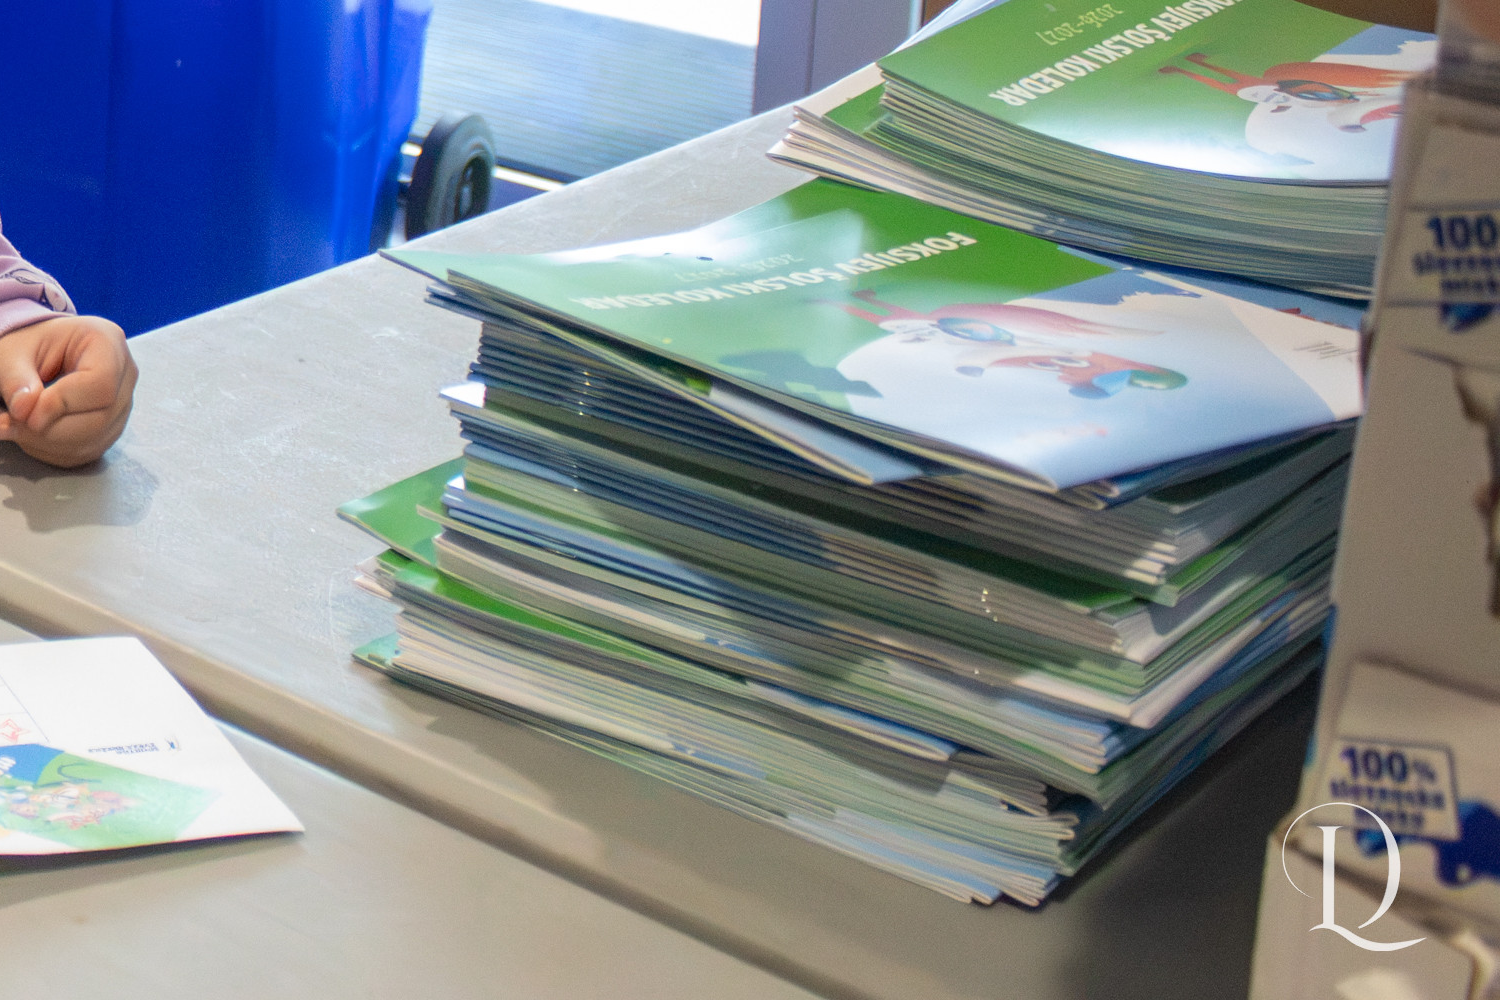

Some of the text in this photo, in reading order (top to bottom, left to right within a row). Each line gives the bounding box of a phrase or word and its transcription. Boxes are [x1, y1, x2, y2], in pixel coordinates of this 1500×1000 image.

[1082, 23, 1172, 64] ŠOLSKI
[988, 55, 1102, 107] KOLEDAR
[568, 231, 978, 311] FOKSIJEV ŠOLSKI KOLEDAR
